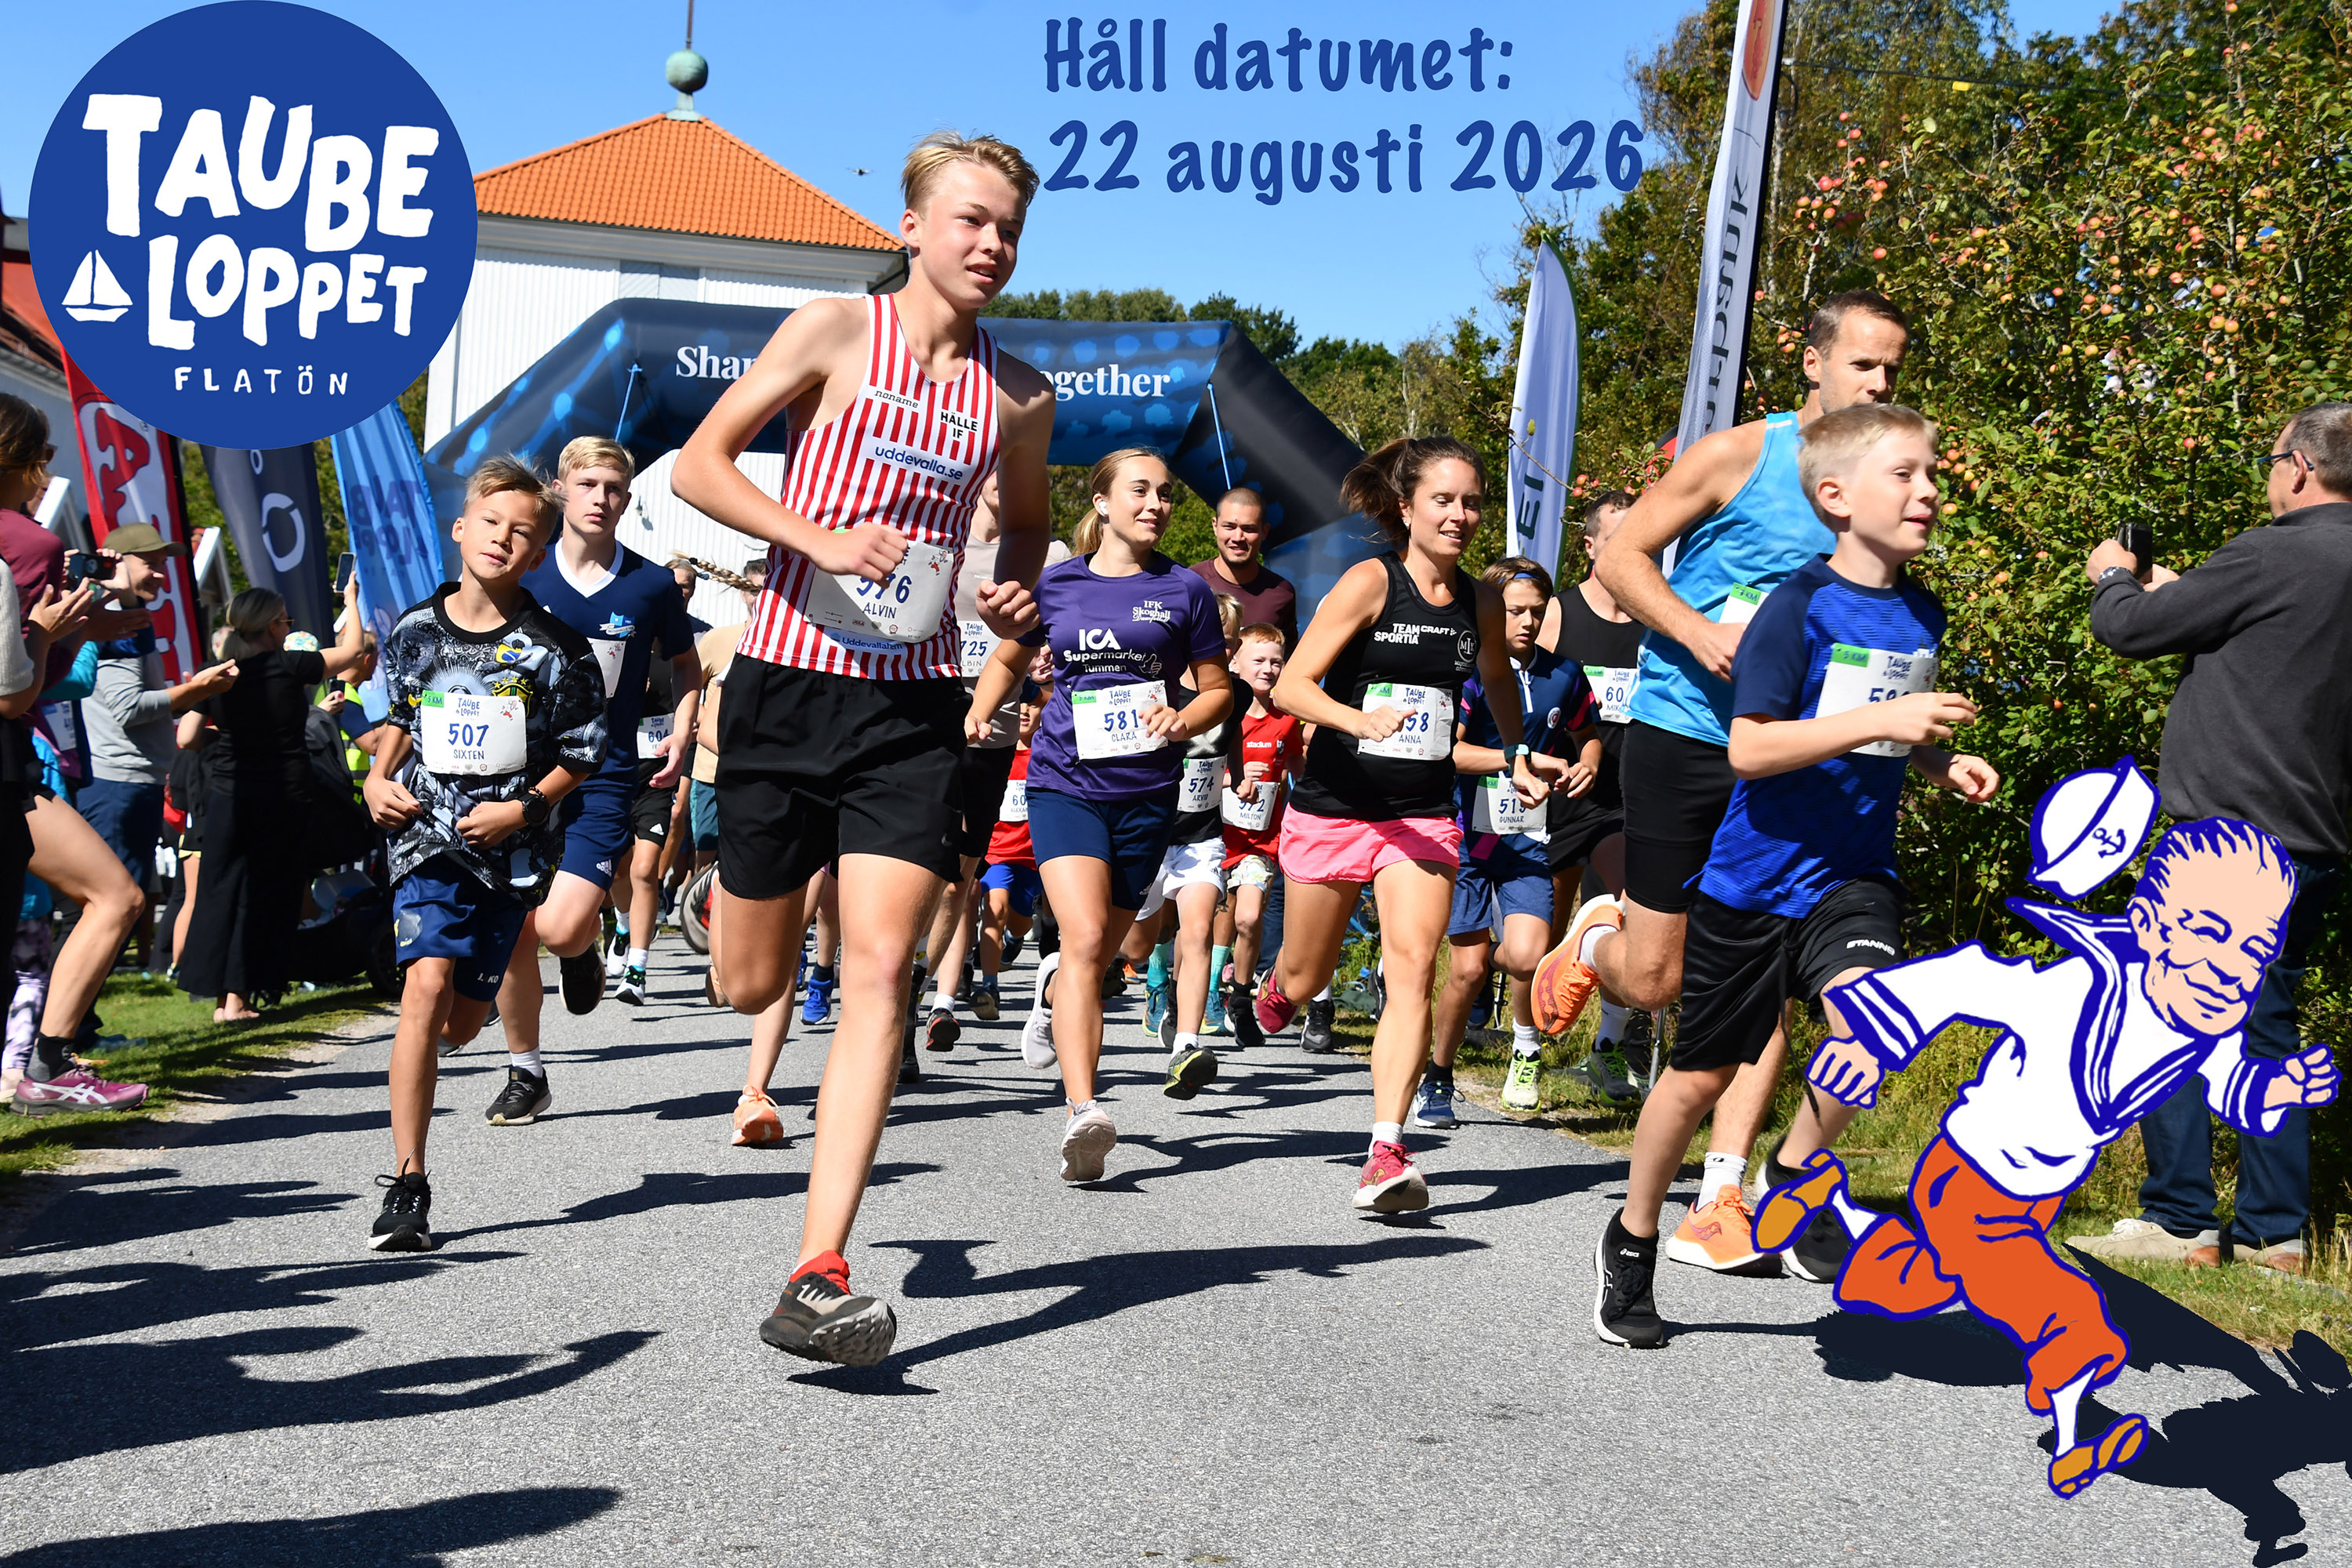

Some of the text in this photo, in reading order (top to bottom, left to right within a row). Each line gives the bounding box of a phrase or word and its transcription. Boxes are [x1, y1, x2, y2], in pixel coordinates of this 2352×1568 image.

[875, 390, 918, 408] noname
[941, 412, 978, 431] HÄLLE
[953, 428, 963, 438] IF
[875, 447, 963, 480] uddevalla.se
[862, 602, 897, 619] ALVIN
[1144, 601, 1163, 609] IFK
[1132, 607, 1171, 619] Skoghall
[1392, 623, 1450, 635] TEAM CRAFT
[1079, 628, 1121, 651] ICA
[1374, 631, 1420, 644] SPORTIA
[1063, 648, 1146, 662] Supermarket
[1083, 664, 1127, 673] Tummen
[1109, 690, 1131, 699] TAUBE
[1406, 688, 1425, 699] TAUBE
[1606, 687, 1624, 702] 60
[458, 698, 480, 710] TAUBE
[460, 708, 479, 717] LOPPET
[1104, 709, 1138, 731] 581
[1406, 712, 1429, 732] 58
[448, 723, 489, 747] 507
[1112, 731, 1138, 742] CLARA
[1399, 734, 1421, 744] ANNA
[453, 750, 485, 760] SIXTEN
[1188, 776, 1214, 793] 574
[1012, 794, 1026, 806] 60
